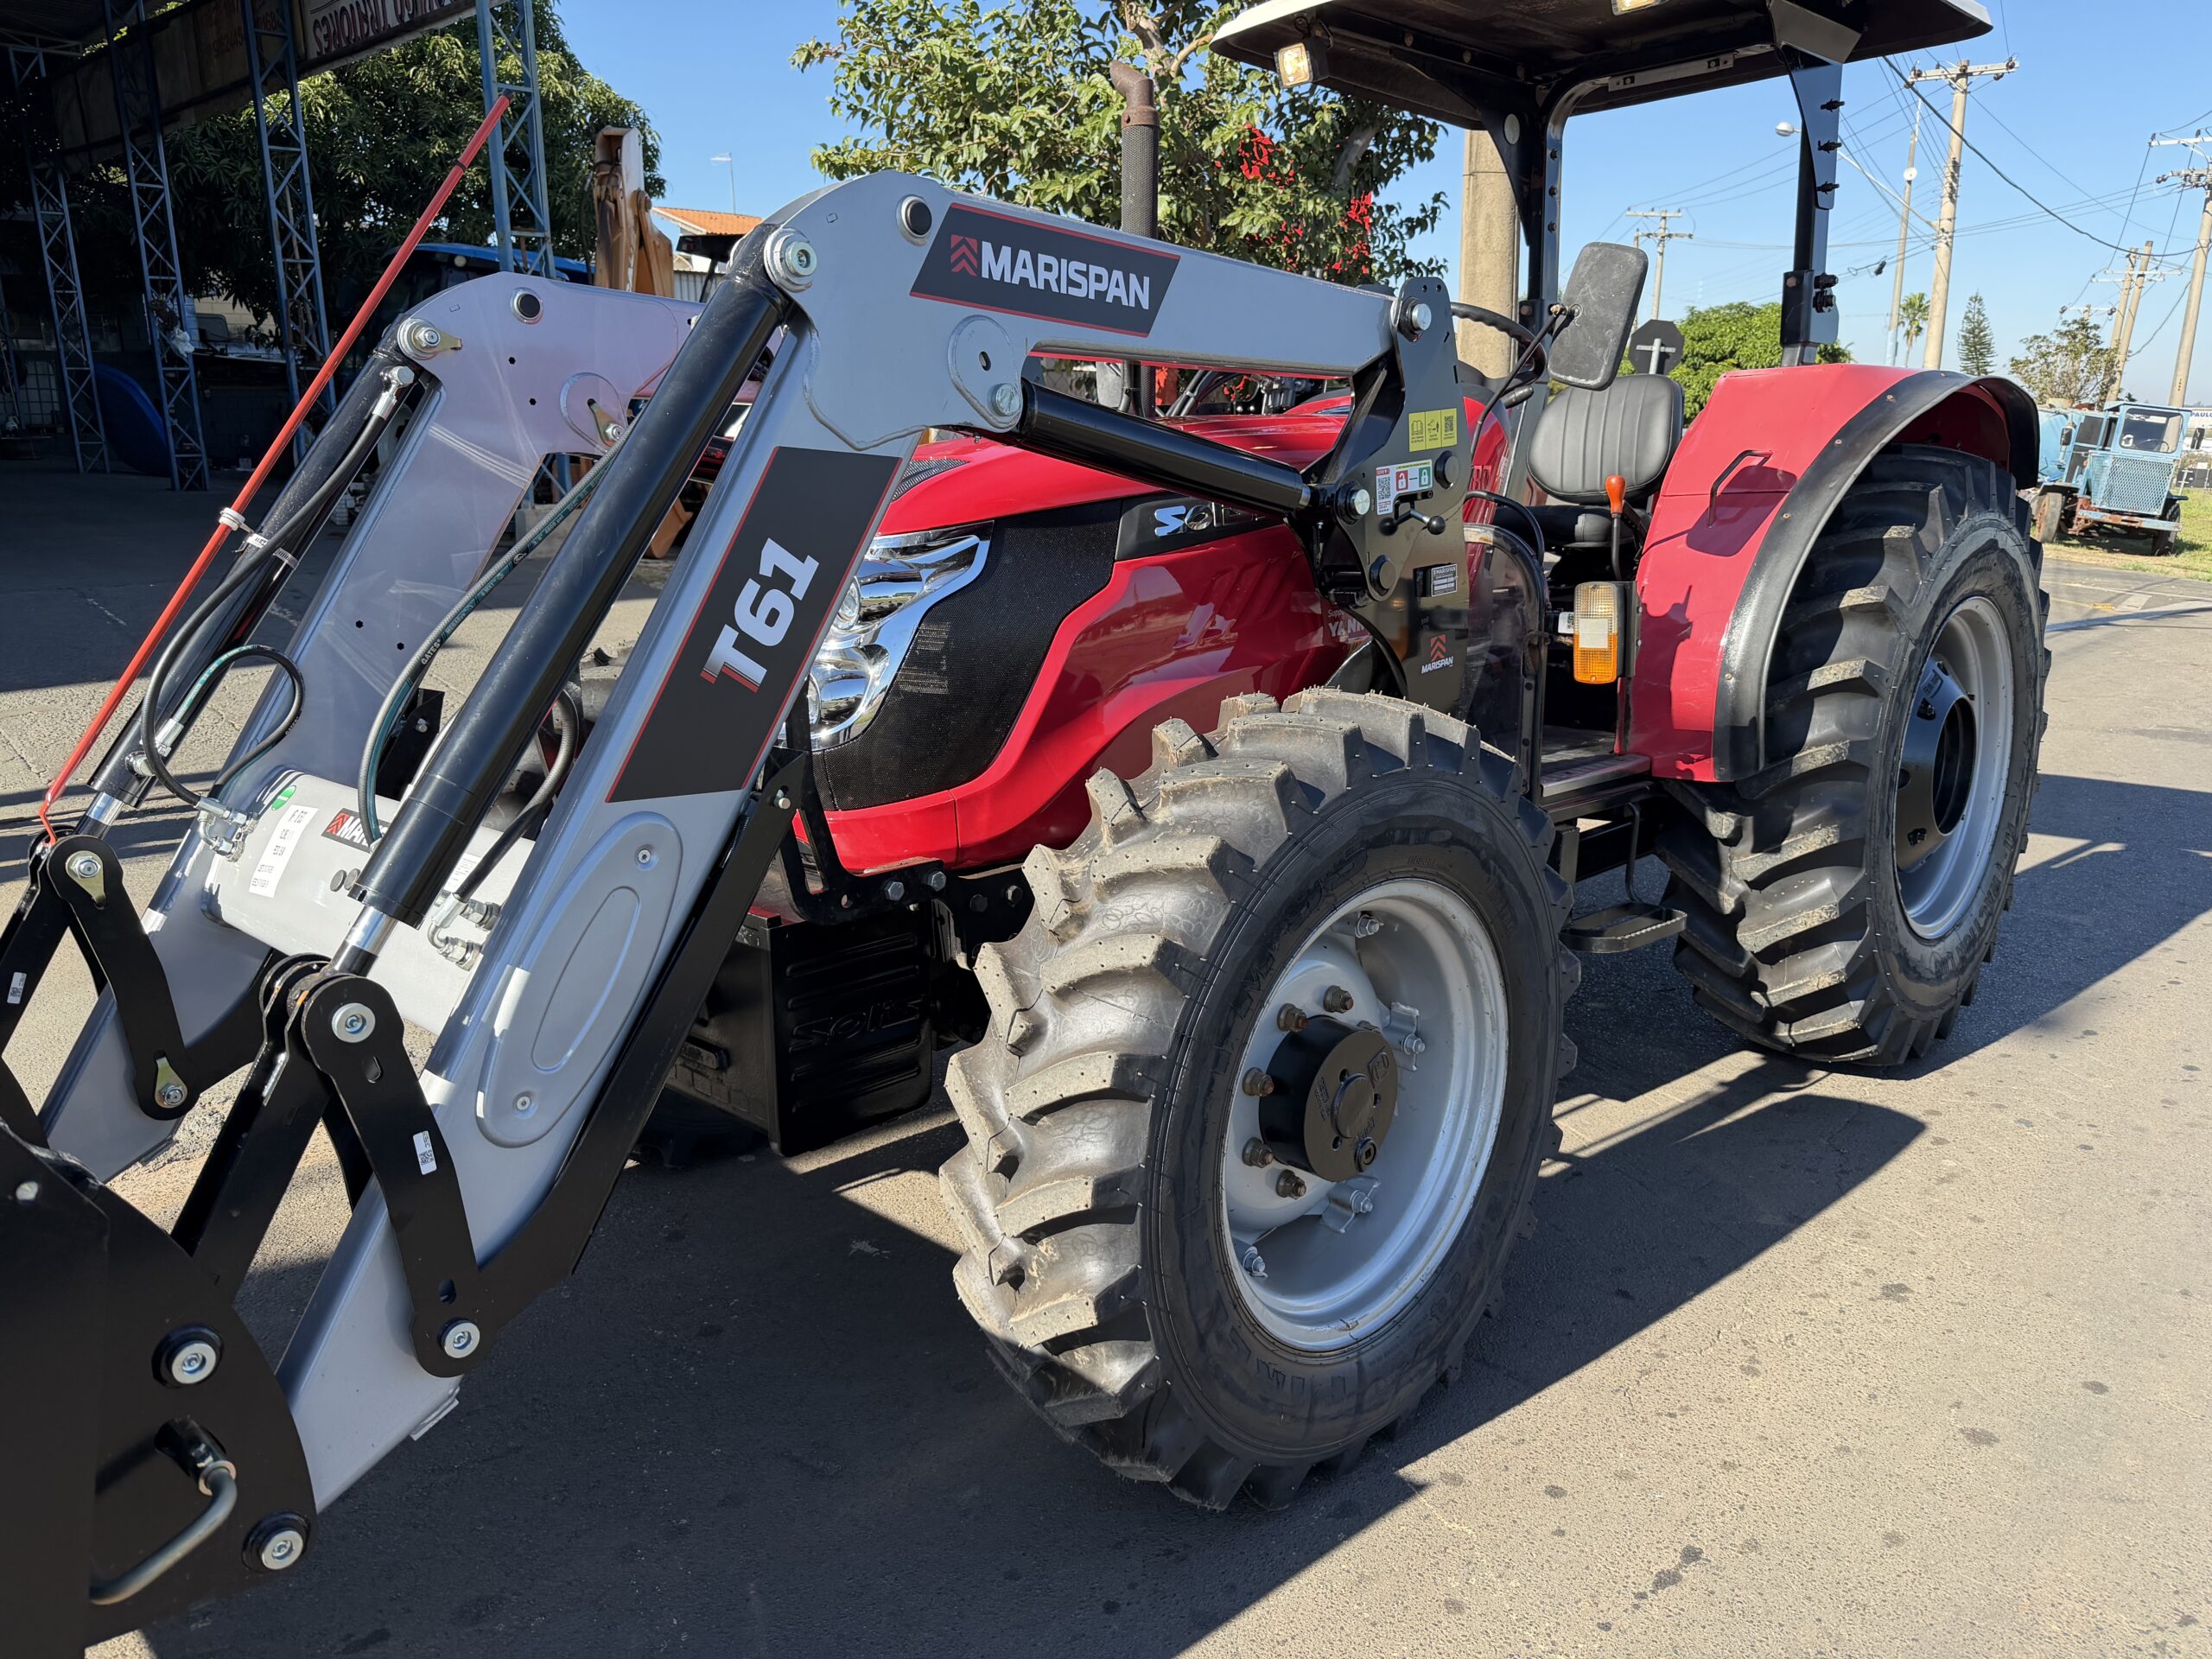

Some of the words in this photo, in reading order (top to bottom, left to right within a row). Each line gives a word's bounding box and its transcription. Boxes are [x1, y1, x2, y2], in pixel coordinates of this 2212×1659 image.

[981, 240, 1150, 310] MARISPAN
[699, 537, 820, 692] T61
[1421, 656, 1453, 674] MARISPAN
